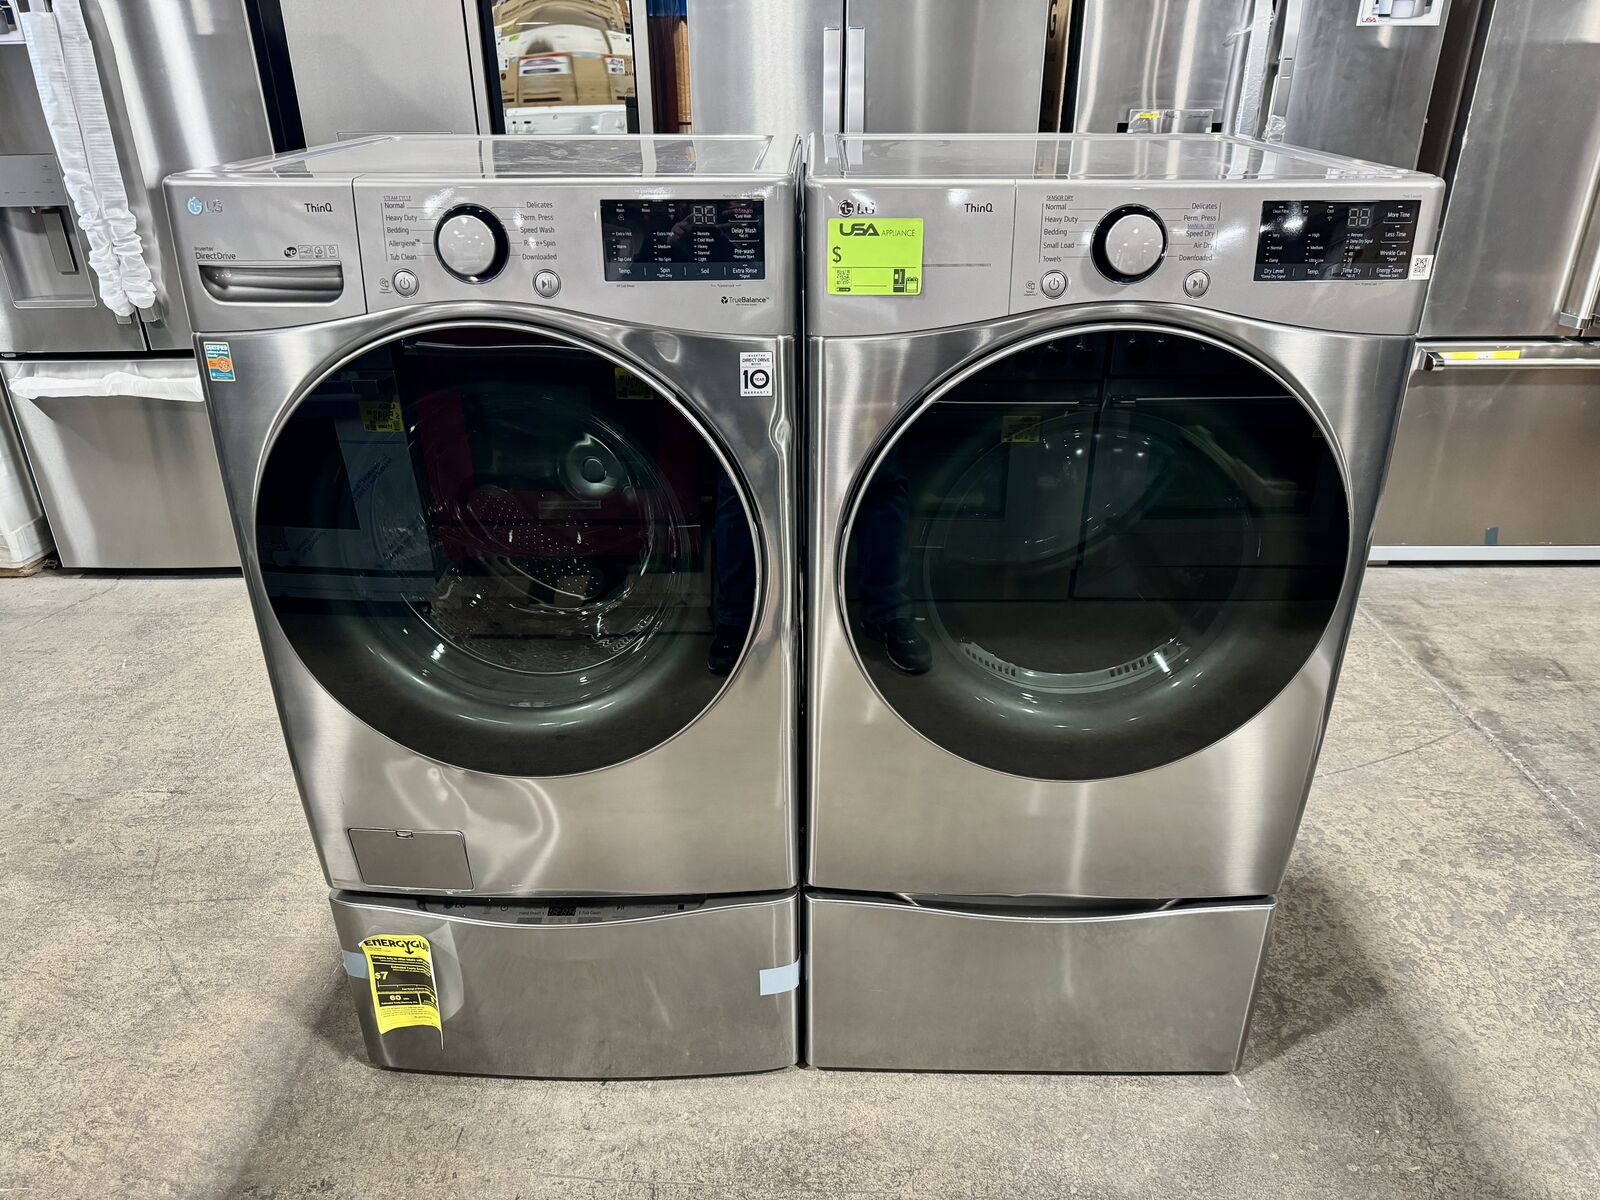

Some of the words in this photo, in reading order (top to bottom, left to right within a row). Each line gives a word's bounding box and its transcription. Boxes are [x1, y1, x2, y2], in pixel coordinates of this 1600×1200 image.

[304, 203, 334, 213] ThinQ
[527, 201, 553, 209] Delicates
[964, 202, 994, 213] ThinQ
[1044, 216, 1062, 224] Heavy
[1064, 216, 1078, 224] Duty
[387, 227, 409, 235] Bedding
[520, 226, 538, 234] Speed
[839, 223, 880, 237] USA
[881, 229, 916, 237] APPLIANCE
[832, 246, 842, 264] $
[743, 369, 770, 389] 10
[375, 971, 388, 980] $7
